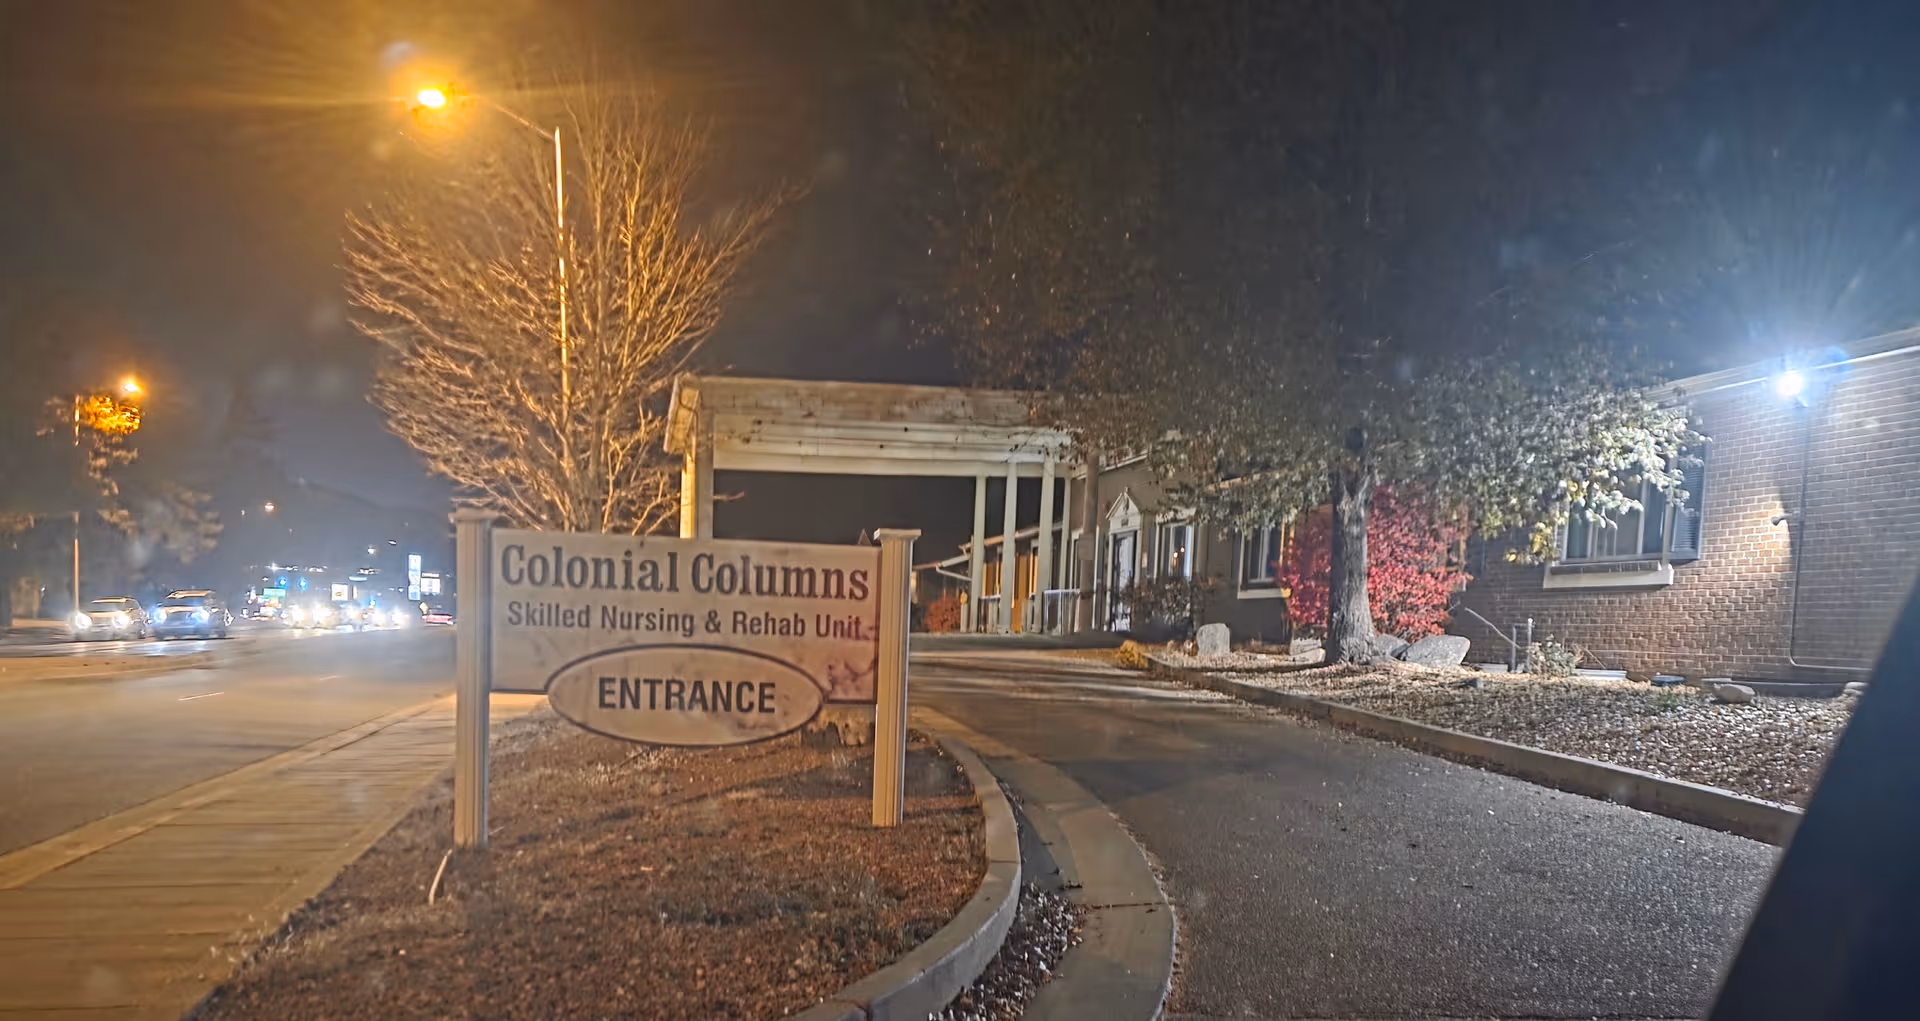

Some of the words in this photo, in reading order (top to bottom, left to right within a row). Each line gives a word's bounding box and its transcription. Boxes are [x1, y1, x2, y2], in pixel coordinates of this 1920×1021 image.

[501, 544, 679, 594] Colonial
[691, 552, 870, 601] Columns
[507, 602, 591, 629] Skilled
[601, 607, 695, 637] Nursing
[705, 610, 722, 634] &
[732, 610, 806, 637] Rehab
[816, 614, 862, 641] Unit
[598, 677, 776, 714] ENTRANCE
